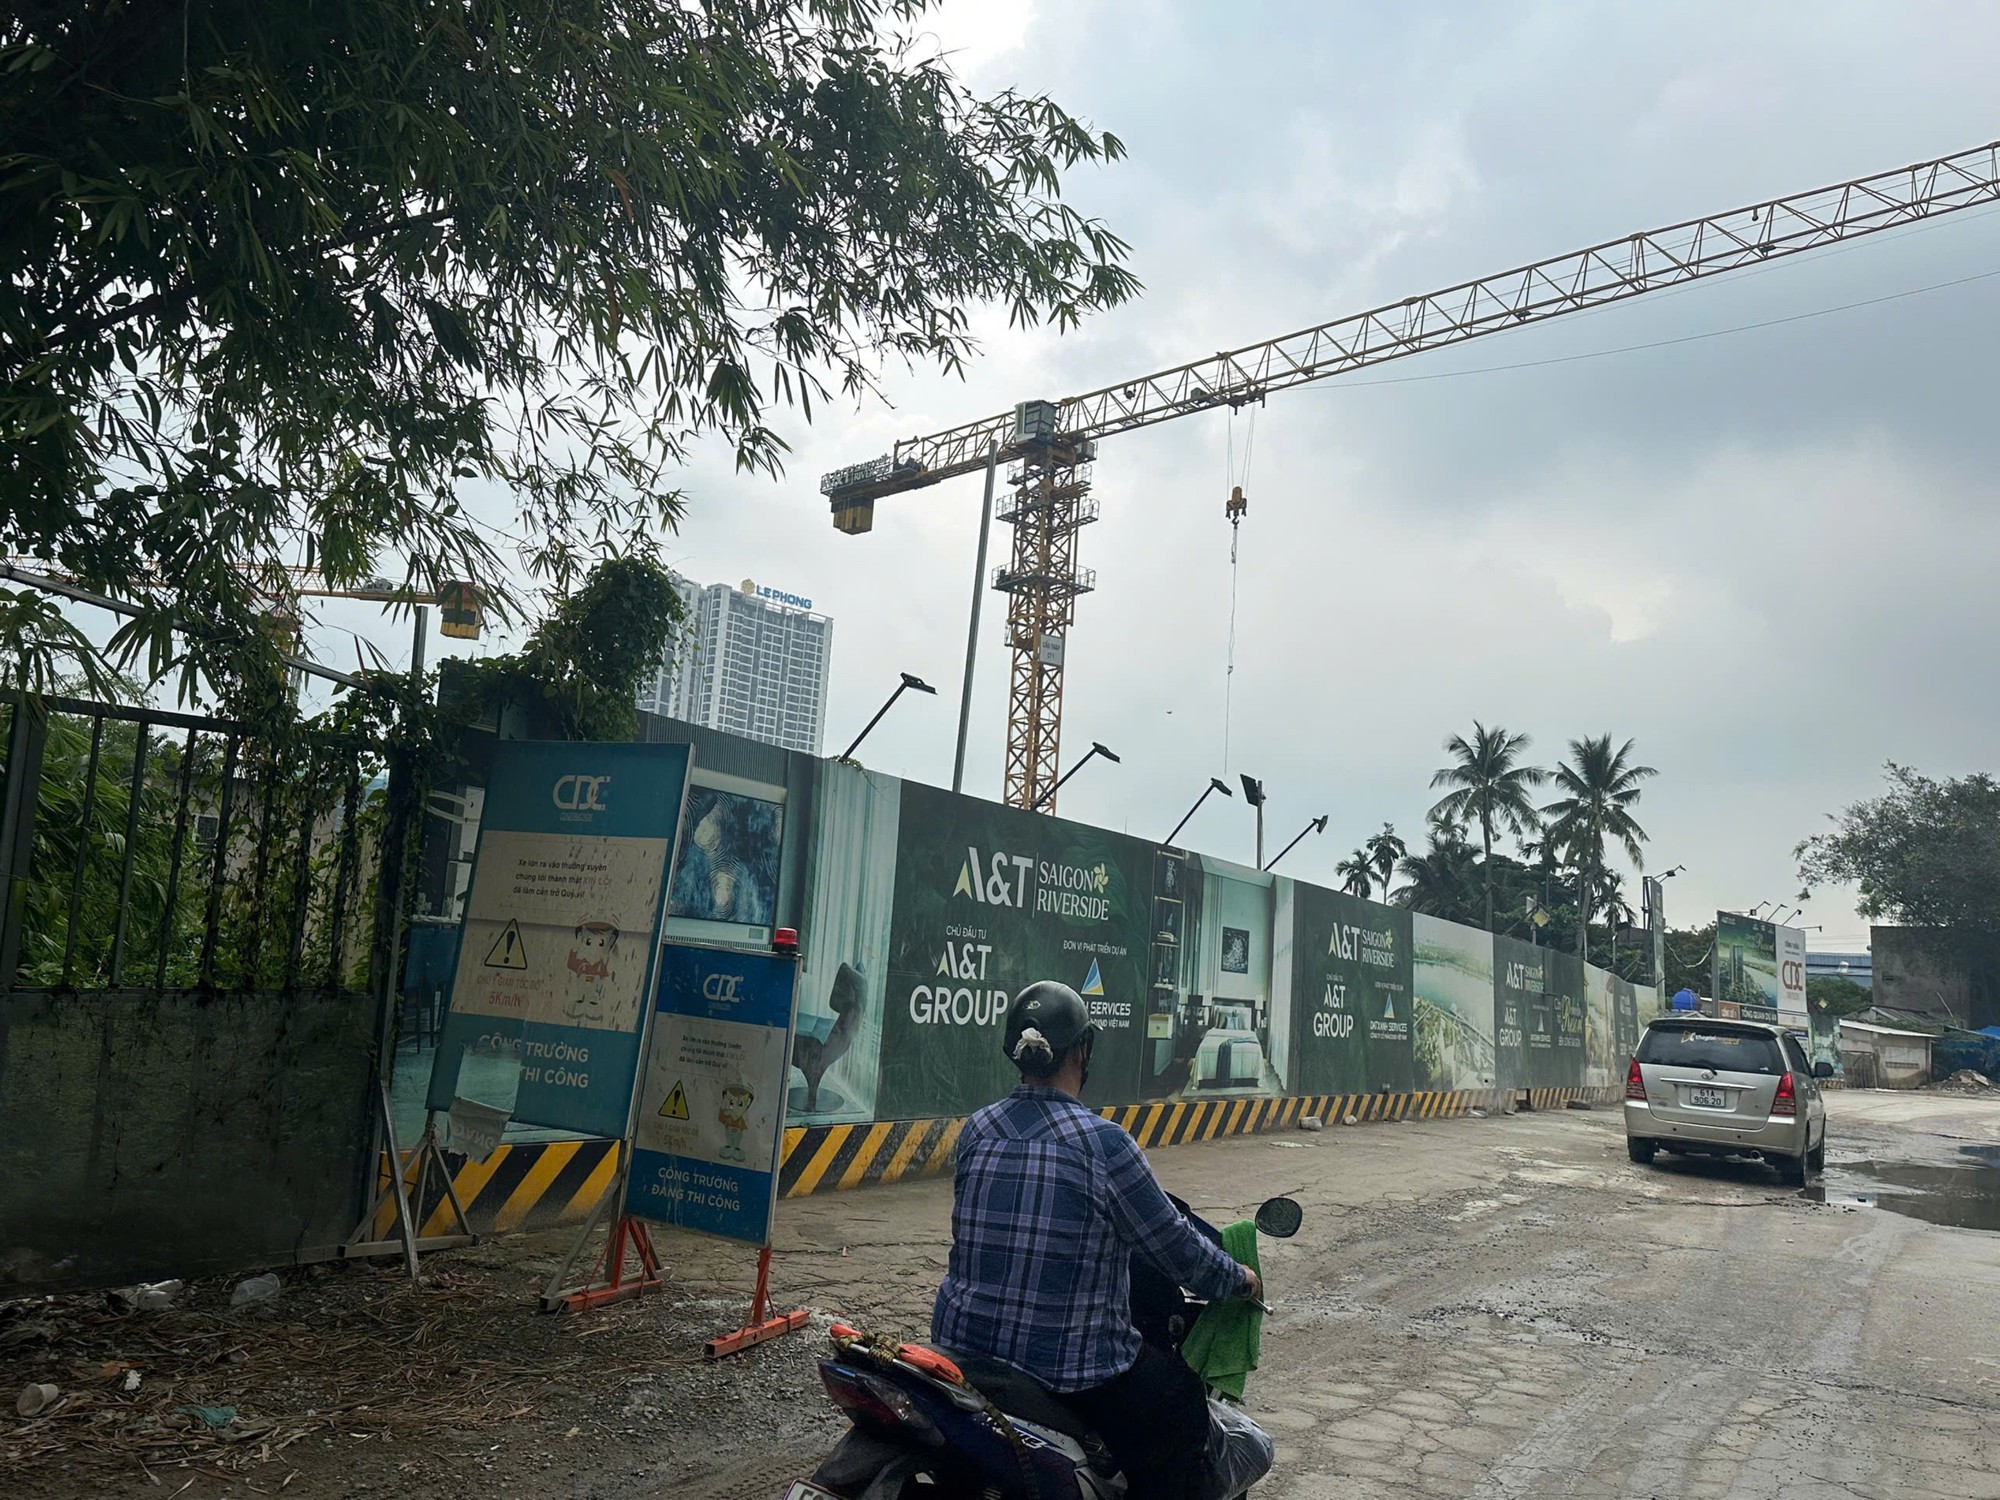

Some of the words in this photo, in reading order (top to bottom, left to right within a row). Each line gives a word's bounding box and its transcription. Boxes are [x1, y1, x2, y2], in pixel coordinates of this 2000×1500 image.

[772, 590, 812, 609] PHONG
[552, 774, 611, 811] CDC
[952, 846, 1033, 908] A&T
[1039, 861, 1094, 892] SAIGON
[1037, 888, 1110, 921] RIVERSIDE
[1328, 922, 1361, 961] A&T
[1362, 929, 1386, 949] SAIGON
[936, 941, 992, 981] A&T
[1362, 947, 1395, 968] RIVERSIDE
[702, 973, 744, 1003] CDC
[1505, 961, 1524, 990] A&T
[1782, 960, 1803, 992] CDC
[909, 984, 1008, 1026] GROUP
[1090, 1001, 1131, 1016] SERVICES
[1323, 983, 1346, 1009] A&T
[1313, 1011, 1354, 1038] GROUP
[1499, 1028, 1522, 1047] GROUP
[526, 1040, 589, 1063] TRƯỜNG
[544, 1067, 589, 1088] CÔNG
[1699, 1088, 1715, 1098] 61A
[658, 1166, 690, 1183] CÔNG
[693, 1173, 738, 1192] TRƯỜNG
[651, 1184, 684, 1200] ĐANG
[687, 1190, 705, 1205] THI
[707, 1194, 740, 1211] CÔNG
